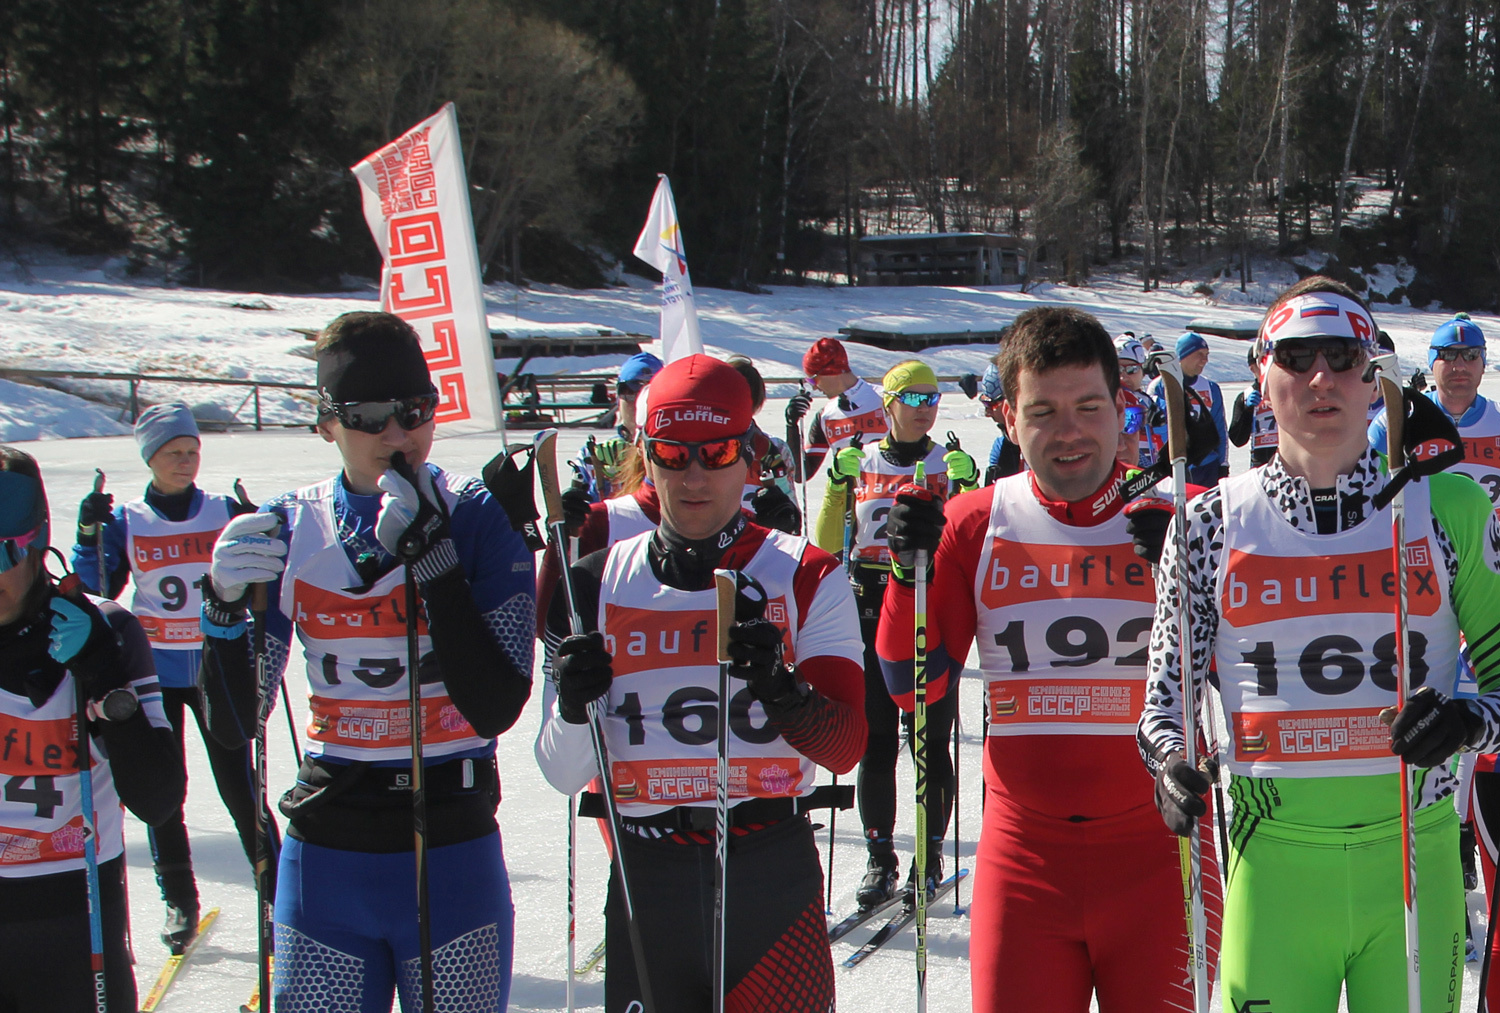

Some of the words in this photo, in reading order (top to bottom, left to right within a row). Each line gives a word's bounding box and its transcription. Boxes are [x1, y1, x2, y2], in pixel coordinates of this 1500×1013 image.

[826, 418, 885, 438] bauflex
[1313, 493, 1339, 502] CRAF
[136, 538, 213, 563] baufle
[990, 556, 1147, 591] baufle
[1229, 564, 1435, 609] bauflex
[158, 575, 202, 632] 9
[994, 615, 1157, 673] 192
[1240, 630, 1431, 697] 168
[614, 686, 784, 746] 160
[1027, 696, 1091, 716] СССР
[336, 717, 389, 741] СССР
[1278, 728, 1348, 754] СССР
[647, 777, 710, 801] СССР
